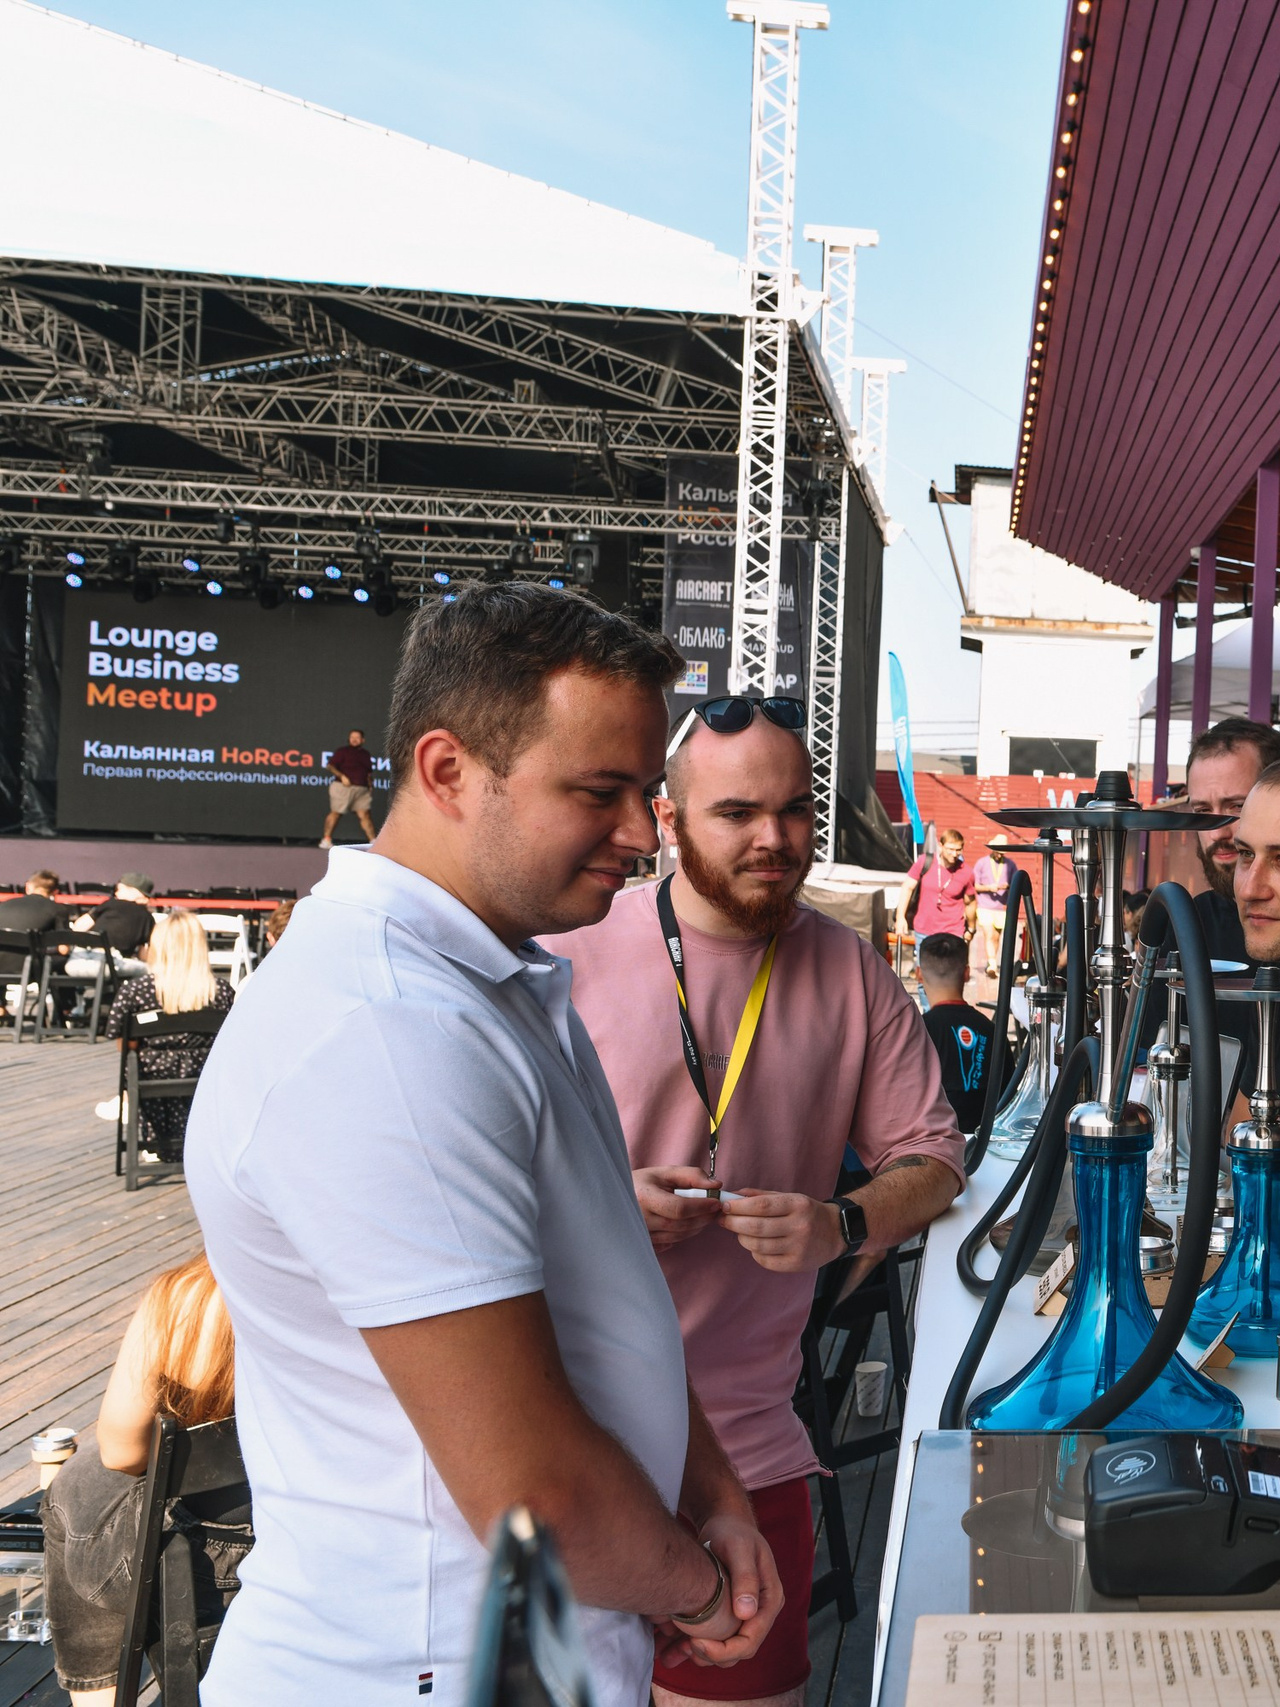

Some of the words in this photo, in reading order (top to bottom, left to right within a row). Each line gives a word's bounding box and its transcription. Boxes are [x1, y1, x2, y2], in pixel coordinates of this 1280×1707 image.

[675, 579, 733, 602] AIRCRAFT
[88, 619, 219, 656] Lounge
[87, 650, 241, 684] Business
[86, 681, 218, 717] Meetup
[83, 739, 215, 764] Кальянная
[220, 746, 314, 768] HoReCa
[82, 763, 144, 778] Первая
[146, 767, 298, 786] профессиональная
